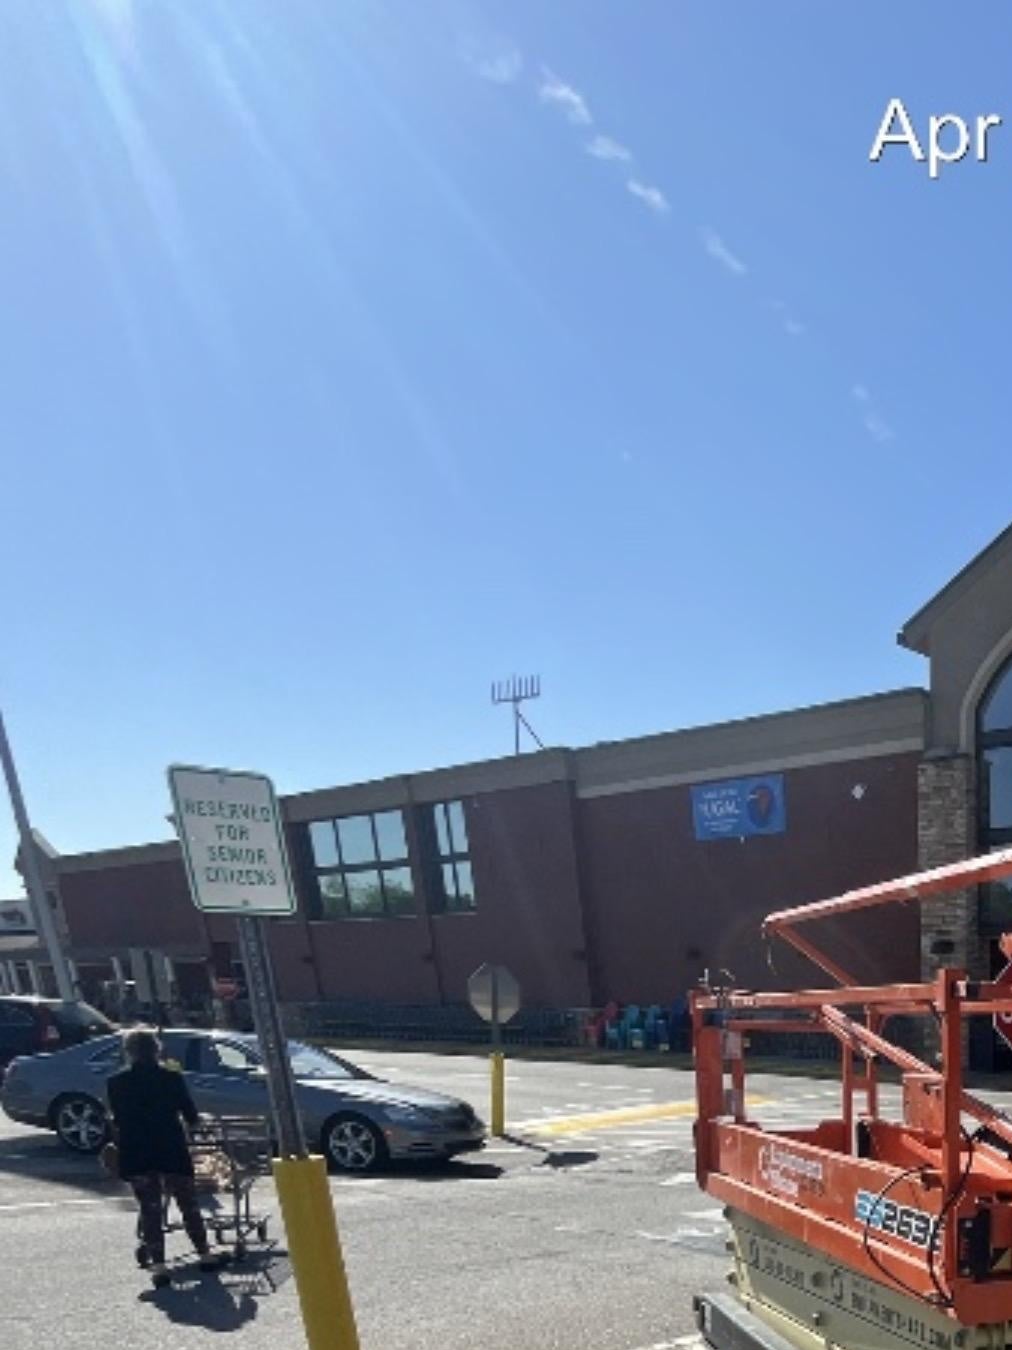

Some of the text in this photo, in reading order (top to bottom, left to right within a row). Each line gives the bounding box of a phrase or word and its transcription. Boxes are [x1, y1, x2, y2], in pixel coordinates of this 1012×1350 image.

[184, 800, 271, 822] RESERVED
[215, 824, 249, 841] FOR
[207, 845, 268, 864] SENIOR
[205, 867, 276, 886] CITIZENS
